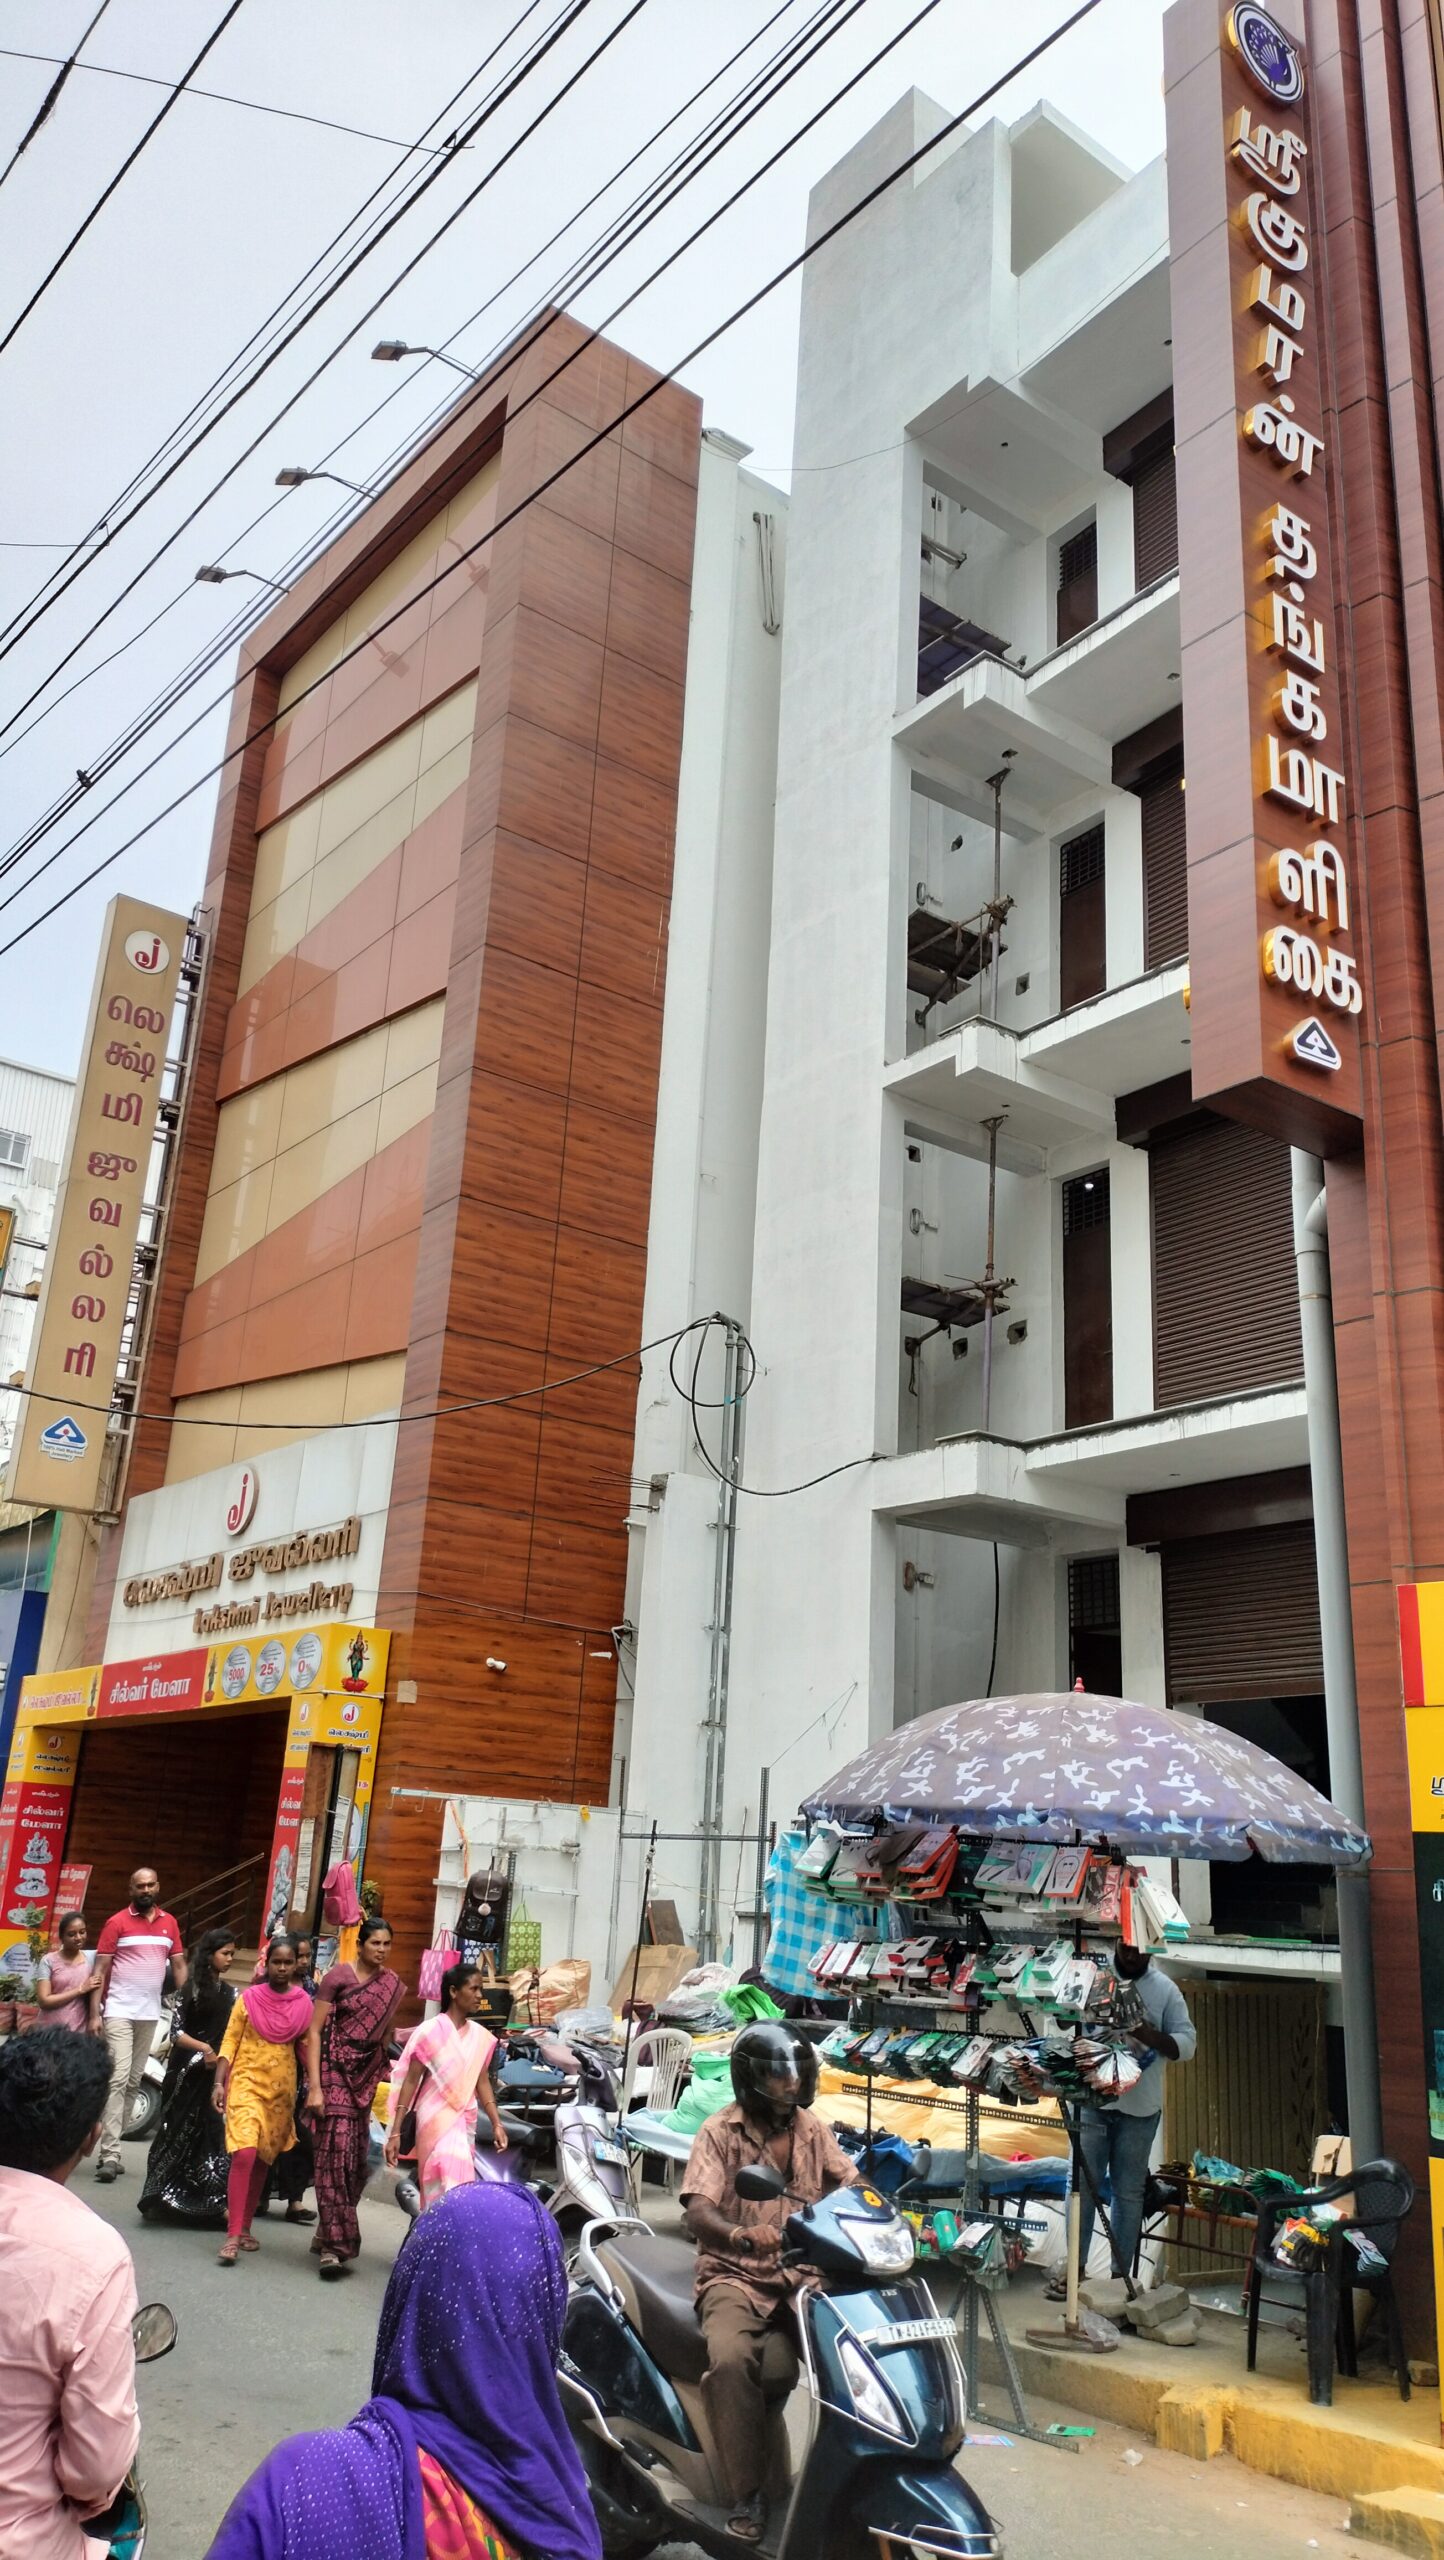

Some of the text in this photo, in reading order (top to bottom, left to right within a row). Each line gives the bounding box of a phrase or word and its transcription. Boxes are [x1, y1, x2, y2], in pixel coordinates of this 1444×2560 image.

[63, 1150, 138, 1378] ஜுவல்லரி
[261, 1580, 353, 1620] Jewellery
[109, 1676, 192, 1705] சில்வர் மேளா
[20, 1818, 63, 1830] மேளா
[22, 1804, 65, 1818] சில்வர்
